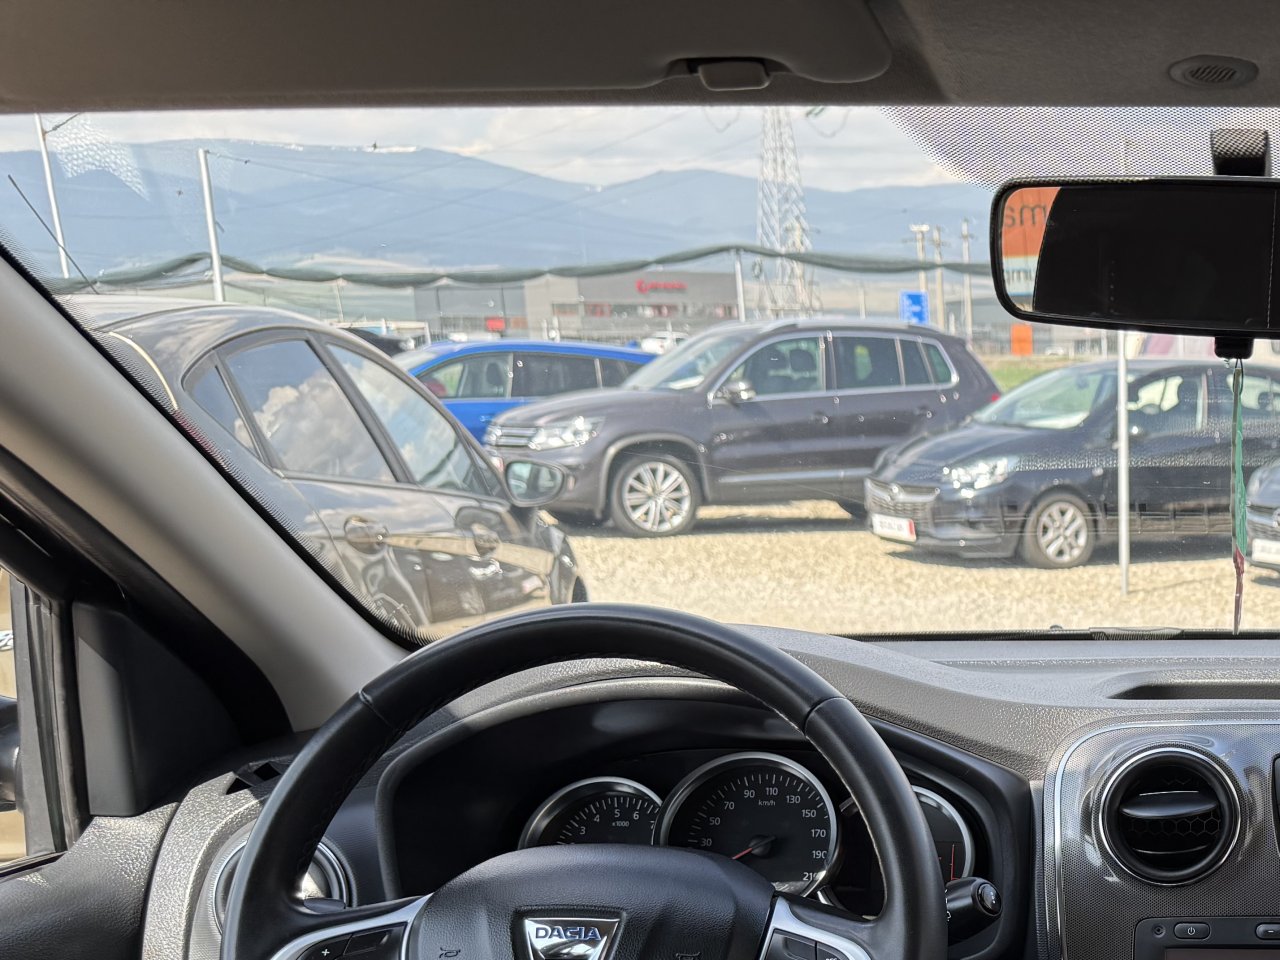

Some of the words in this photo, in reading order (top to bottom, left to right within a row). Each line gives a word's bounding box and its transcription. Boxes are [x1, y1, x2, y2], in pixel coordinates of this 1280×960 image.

[744, 790, 755, 798] 90
[766, 787, 778, 796] 110
[786, 795, 800, 804] 130
[724, 801, 735, 810] 70
[594, 814, 600, 822] 4
[614, 809, 620, 818] 5
[633, 811, 639, 820] 6
[802, 809, 816, 818] 150
[709, 817, 720, 826] 50
[580, 826, 586, 834] 3
[811, 829, 826, 838] 170
[700, 838, 712, 846] 30
[812, 850, 827, 859] 190
[535, 926, 601, 940] DACIA
